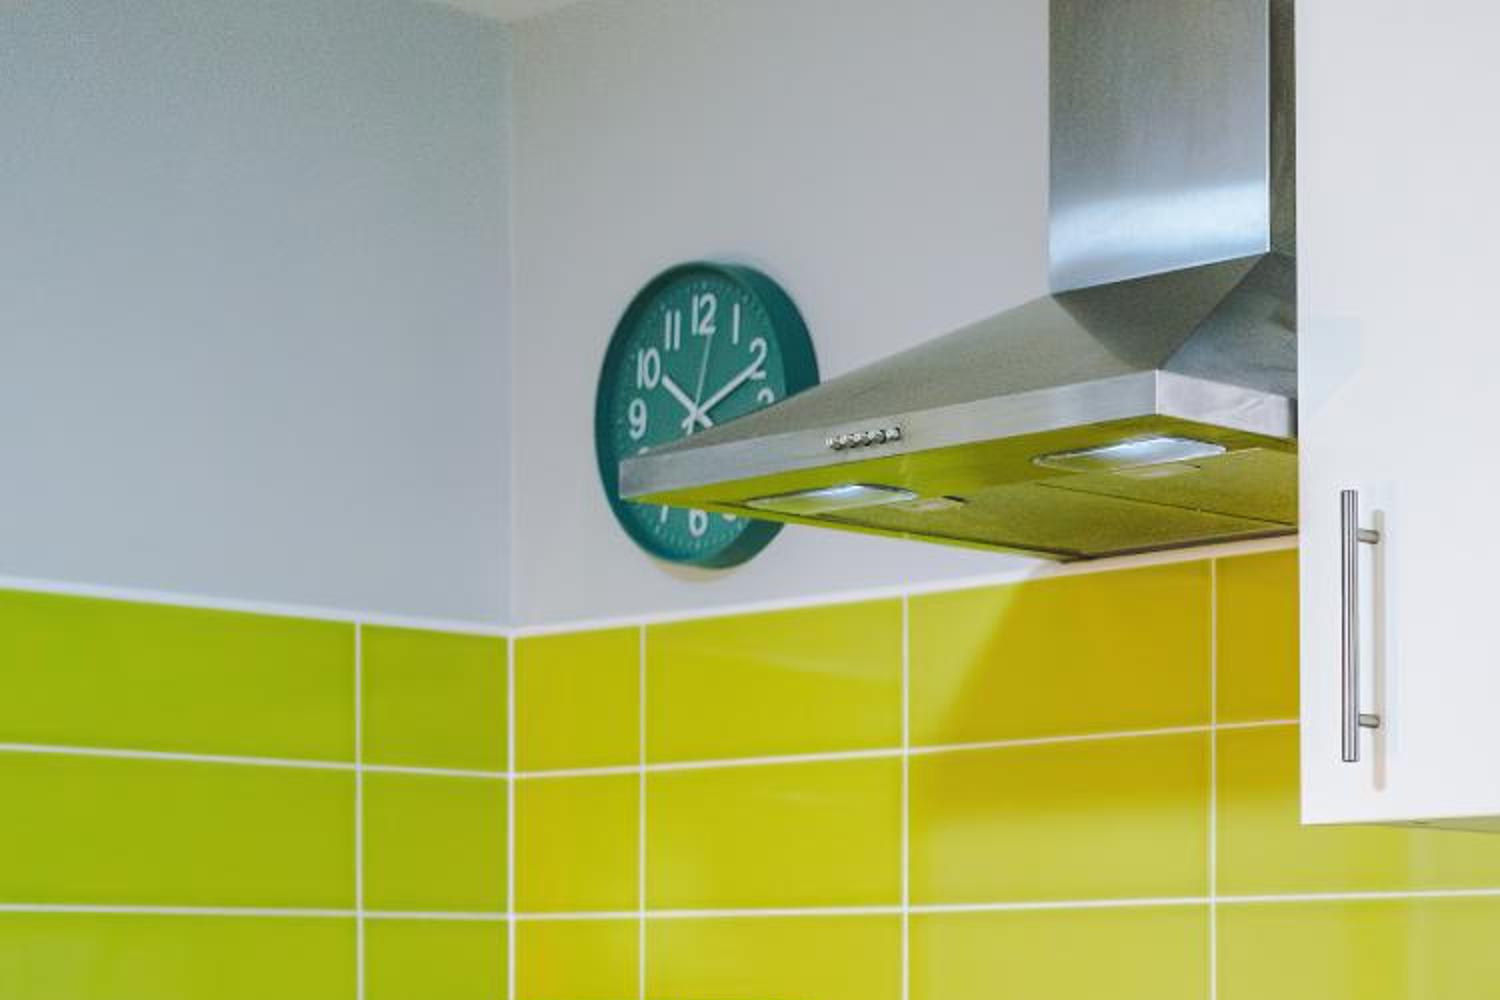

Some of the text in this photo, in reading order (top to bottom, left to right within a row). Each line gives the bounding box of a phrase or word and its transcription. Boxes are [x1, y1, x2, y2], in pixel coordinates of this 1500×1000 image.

[665, 309, 681, 351] 11
[691, 292, 717, 336] 12
[732, 302, 740, 345] 1
[636, 346, 661, 390] 10
[748, 336, 767, 380] 2
[628, 397, 648, 440] 9
